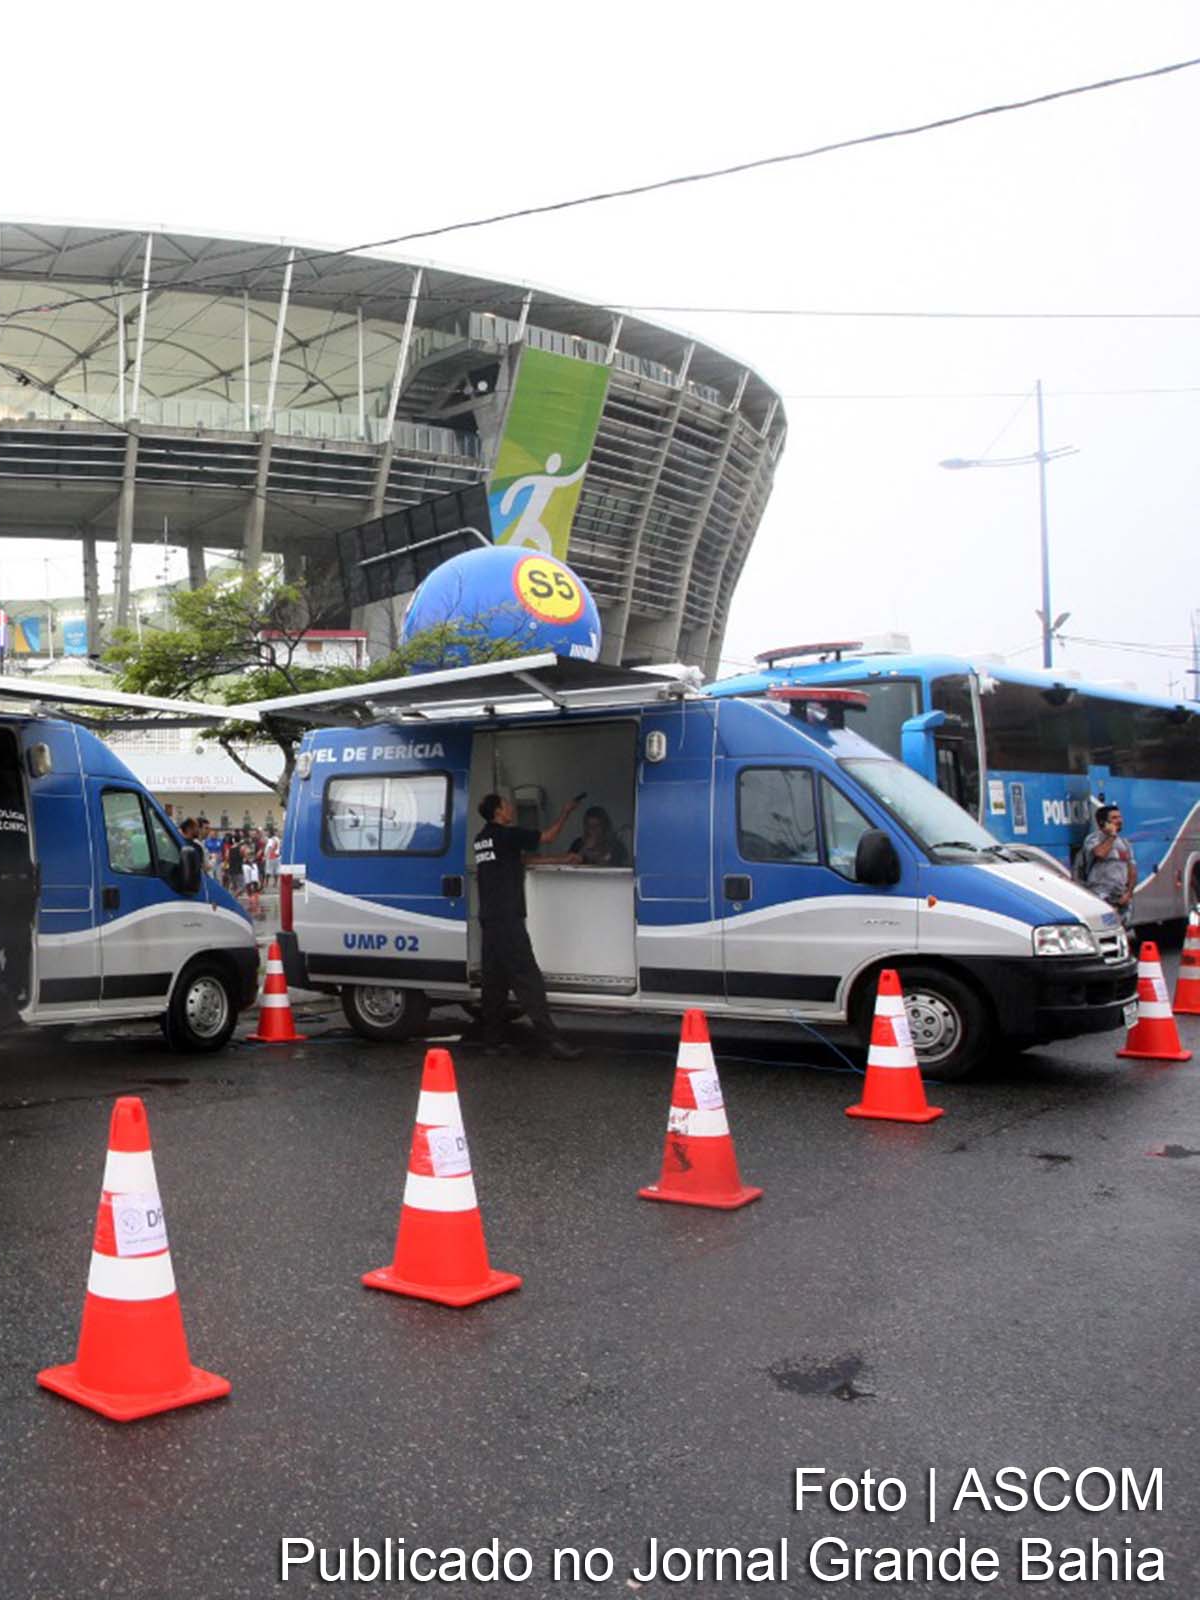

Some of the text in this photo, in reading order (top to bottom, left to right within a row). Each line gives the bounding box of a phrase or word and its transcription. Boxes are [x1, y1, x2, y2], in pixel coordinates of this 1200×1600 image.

[528, 569, 575, 600] S5
[342, 746, 367, 763] DE
[372, 740, 445, 761] PERÍCIA
[343, 932, 420, 952] UMP 02
